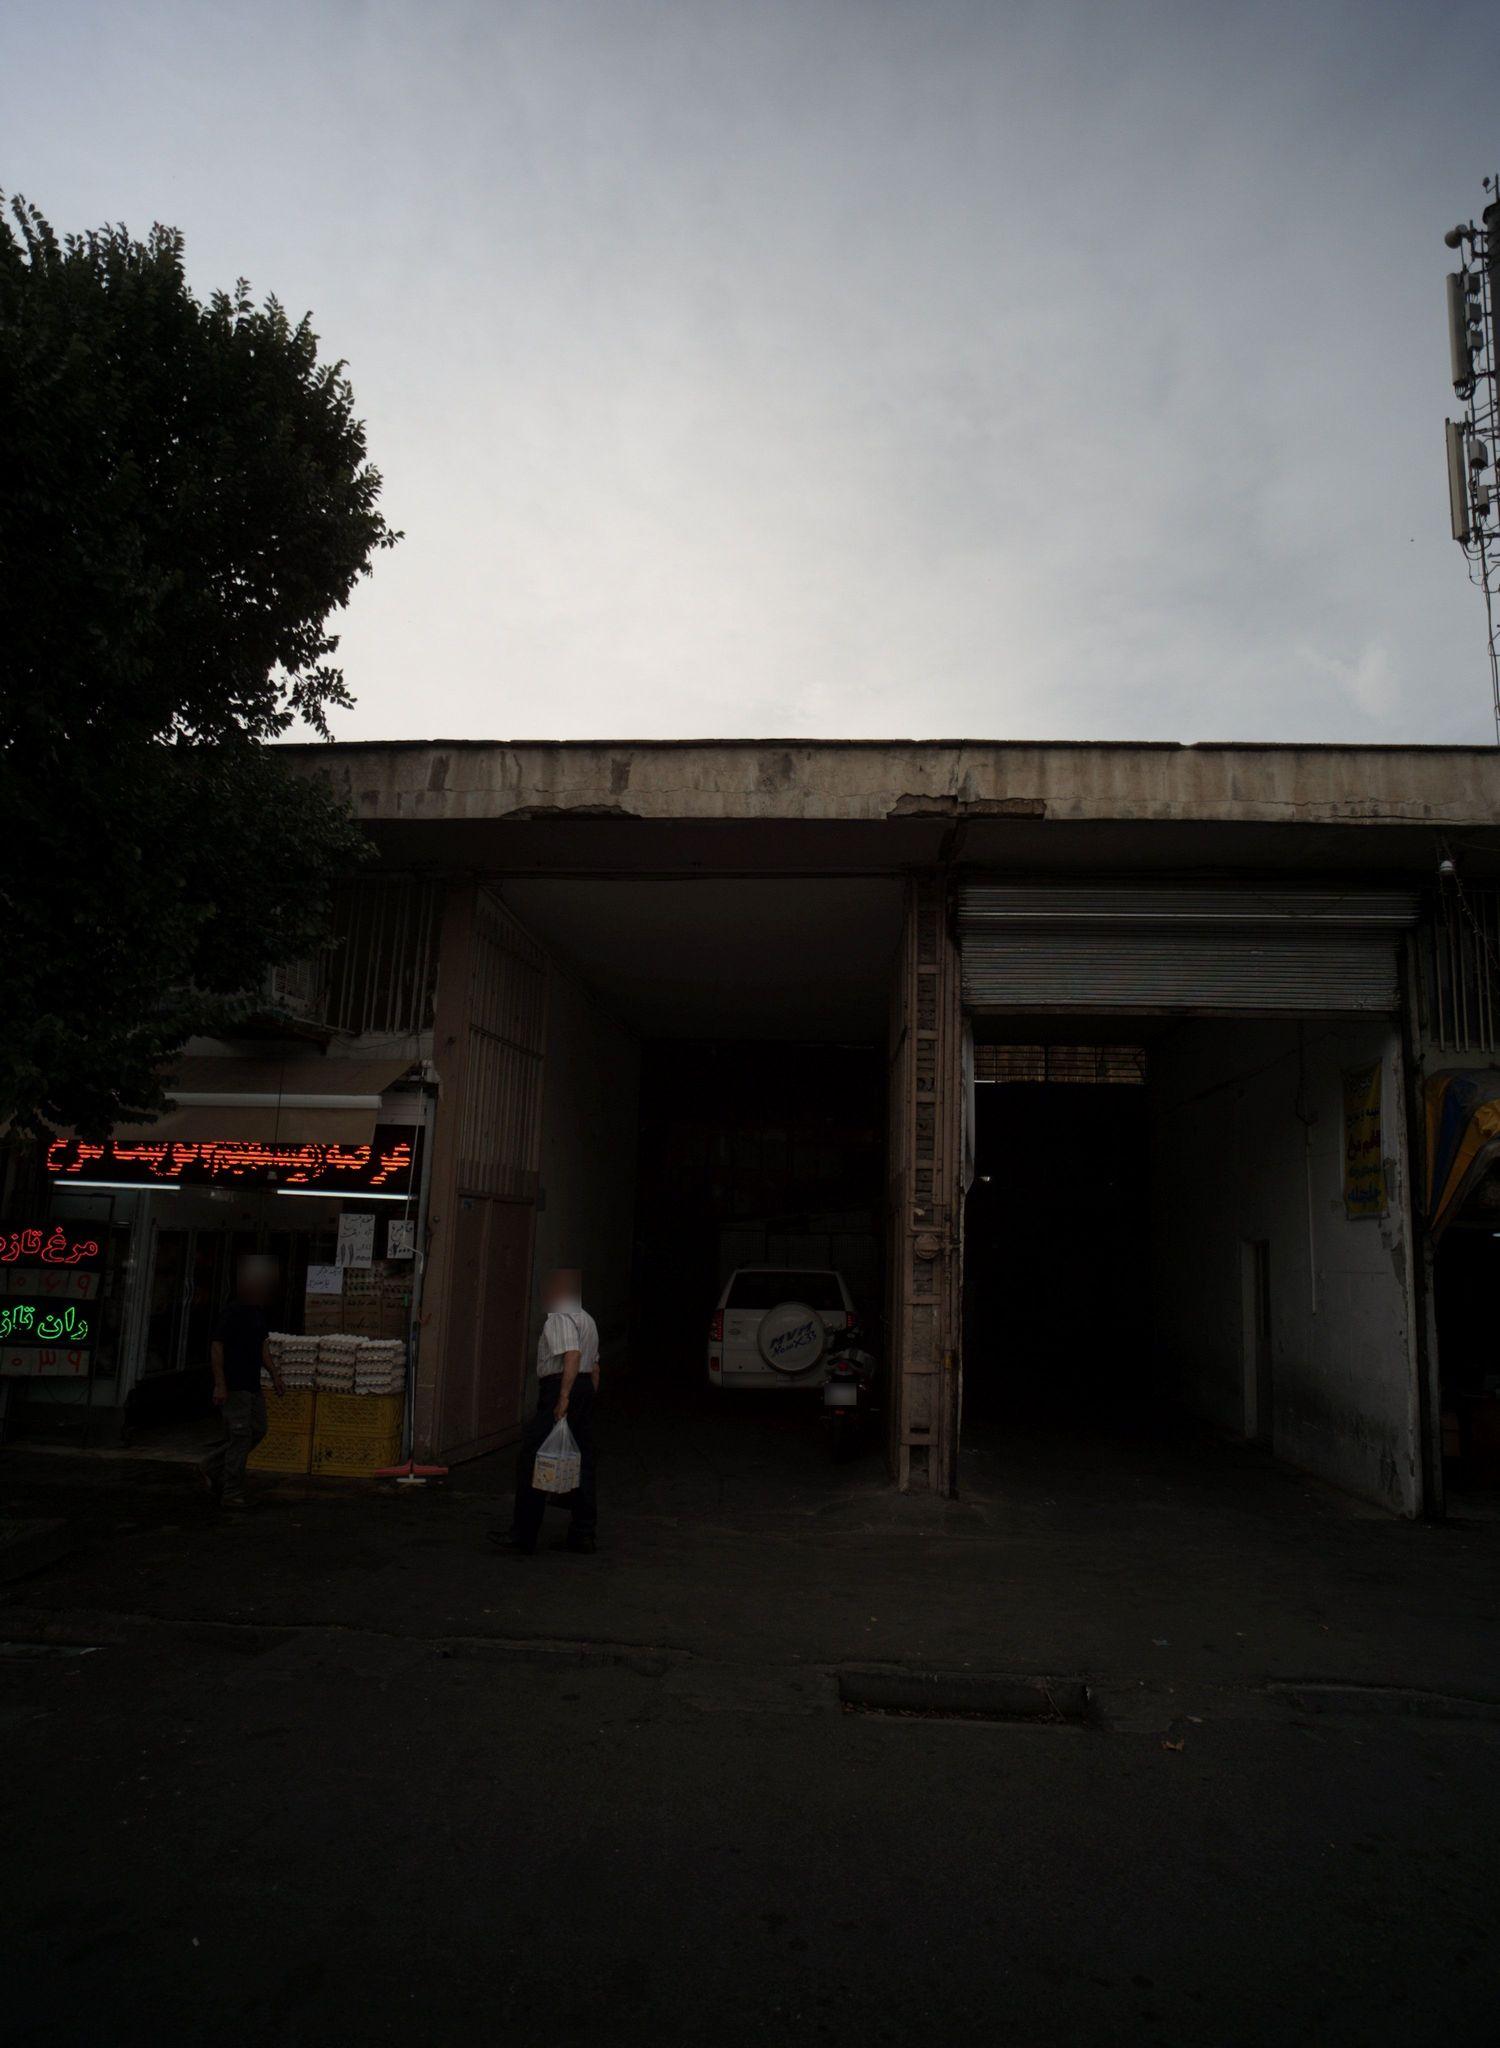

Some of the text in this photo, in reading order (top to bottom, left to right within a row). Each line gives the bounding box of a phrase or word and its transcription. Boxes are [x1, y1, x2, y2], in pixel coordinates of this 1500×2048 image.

[41, 1225, 100, 1264] مرغ
[0, 1303, 89, 1341] ران تاز
